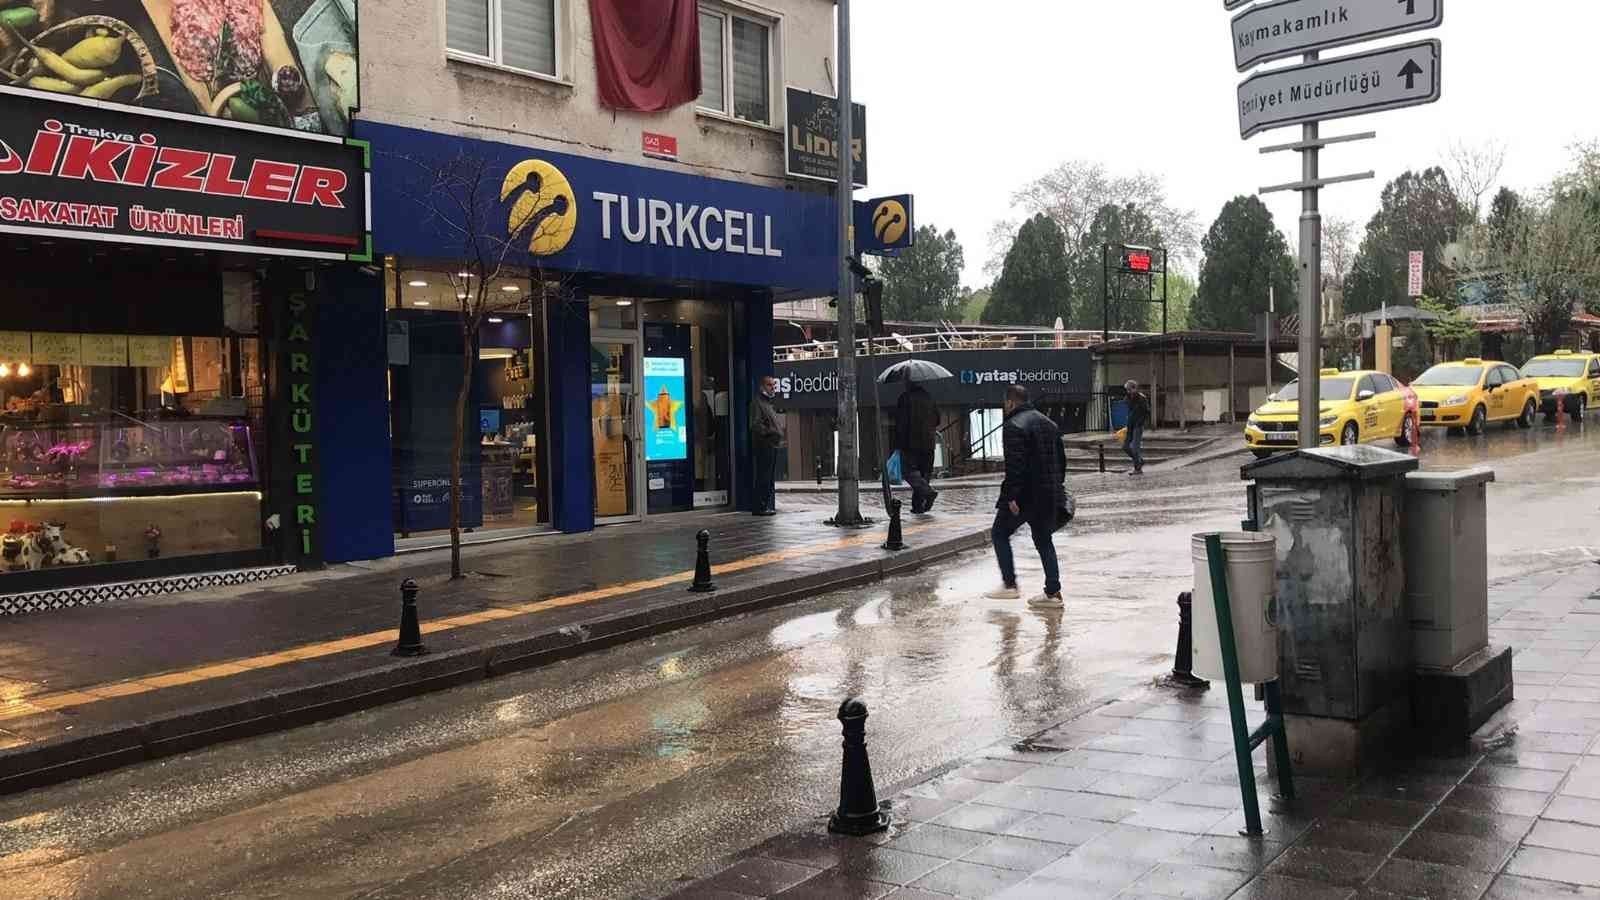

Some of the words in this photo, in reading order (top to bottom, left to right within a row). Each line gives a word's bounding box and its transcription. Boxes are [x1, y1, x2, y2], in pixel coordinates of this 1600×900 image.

[1238, 6, 1349, 48] Kaymakamlık
[1290, 71, 1381, 101] Müdürlüğü
[64, 122, 135, 142] Trakya
[24, 119, 347, 208] İKİZLER
[0, 197, 119, 229] SAKATAT
[129, 204, 244, 240] ÜRÜNLERİ
[592, 191, 783, 257] TURKCELL
[794, 371, 839, 393] beddi
[975, 368, 1018, 384] yataş
[1019, 369, 1069, 384] bedding
[288, 292, 315, 554] ŞARKÜTERİ
